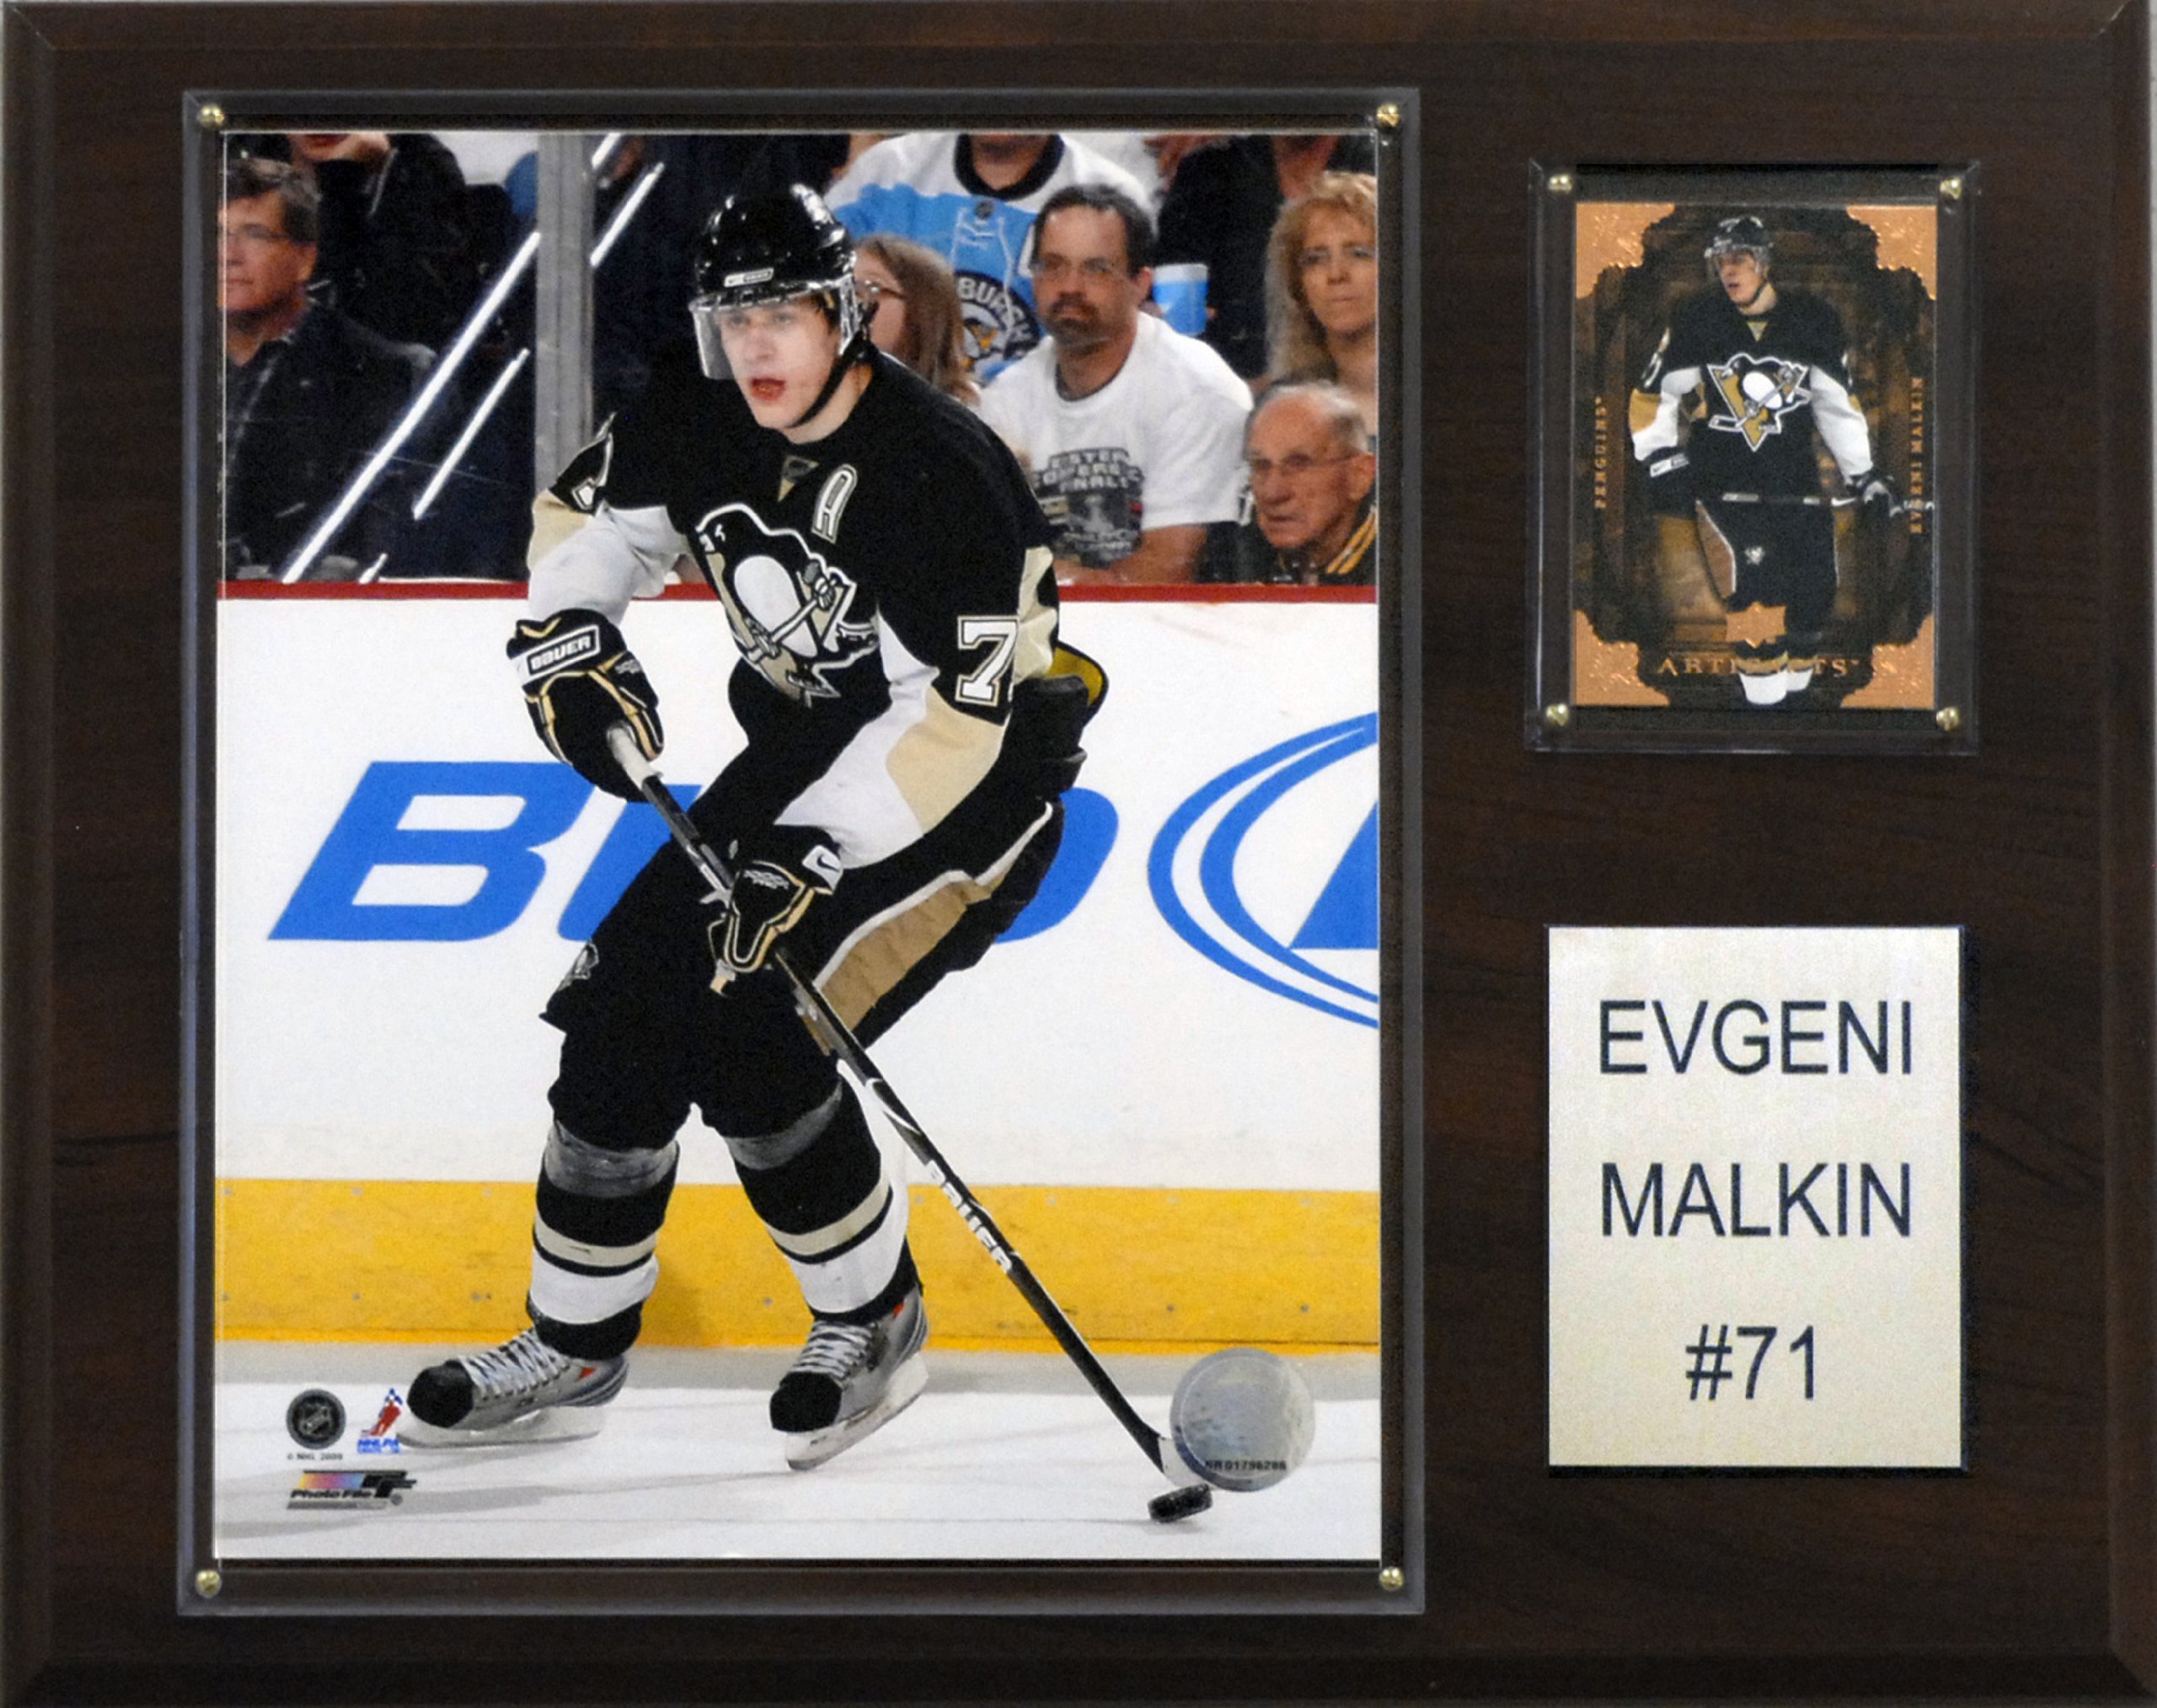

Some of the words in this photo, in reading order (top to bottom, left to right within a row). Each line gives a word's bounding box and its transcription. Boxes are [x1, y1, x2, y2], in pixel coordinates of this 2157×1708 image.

[1910, 463, 1923, 533] EVENI
[530, 634, 591, 672] BAUER
[955, 614, 1020, 706] 7
[1657, 656, 1849, 677] ARTITS
[1600, 999, 1912, 1075] EVGENI
[1602, 1162, 1911, 1237] MALKIN
[1685, 1324, 1814, 1401] #71
